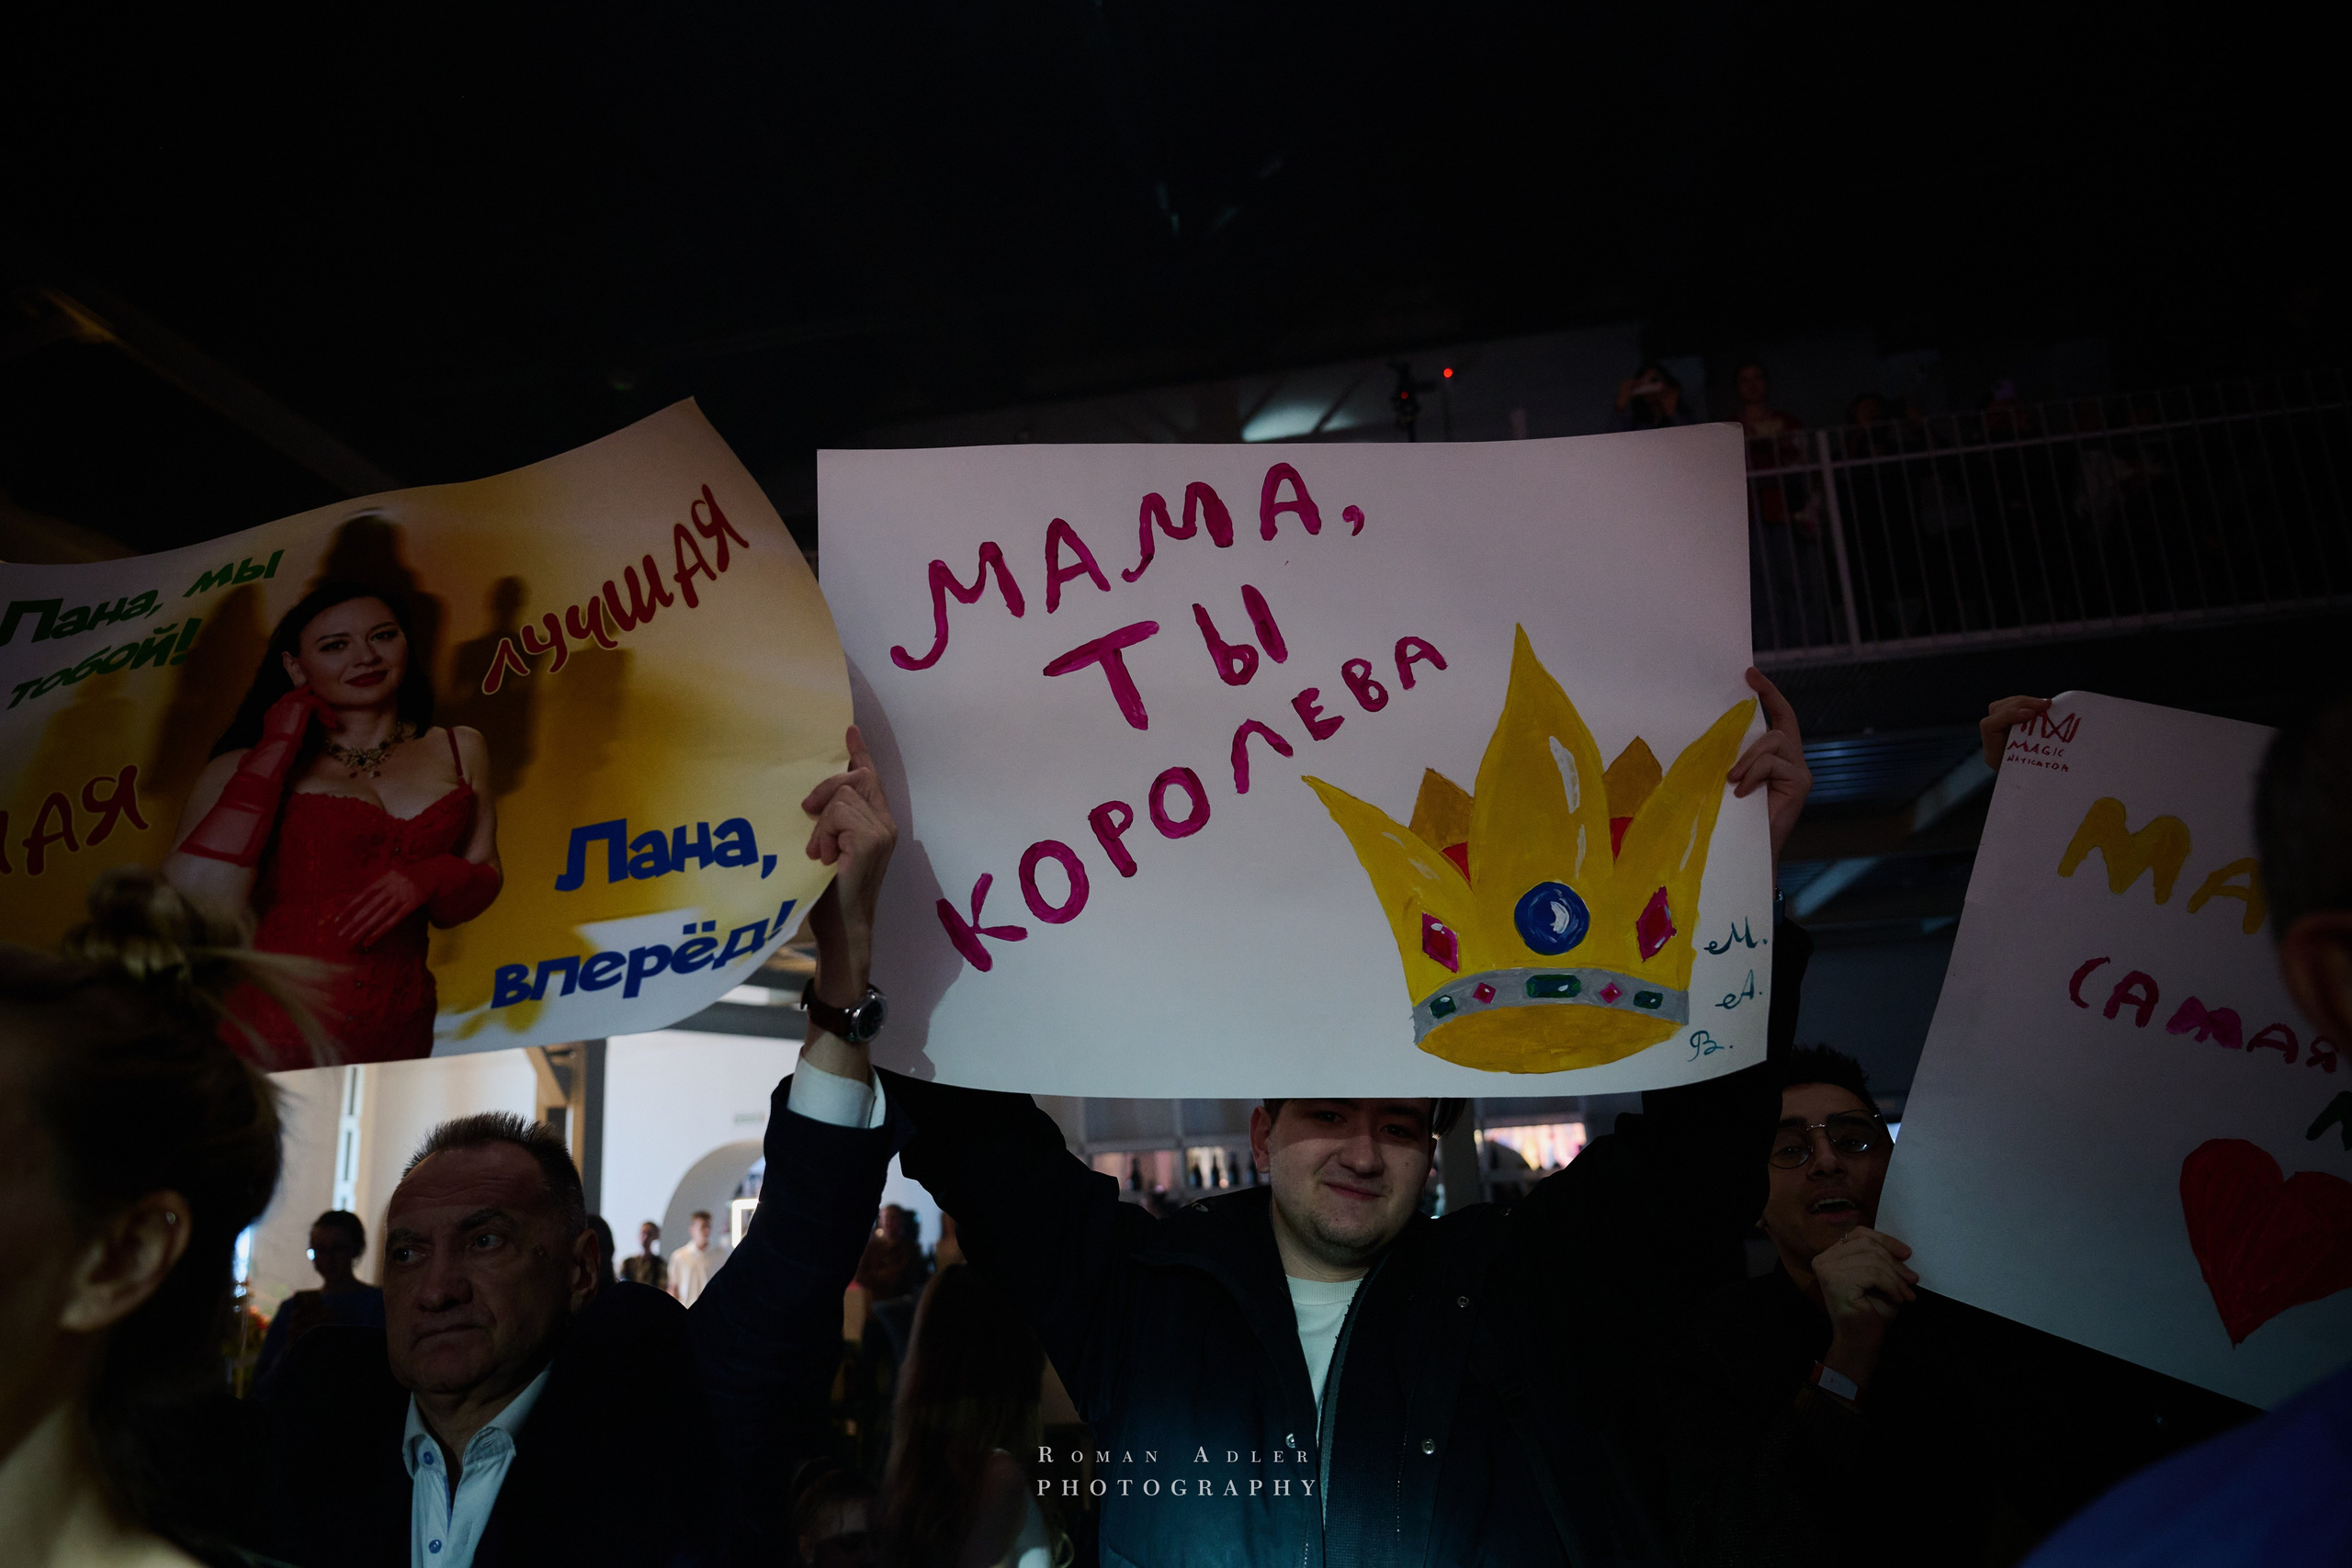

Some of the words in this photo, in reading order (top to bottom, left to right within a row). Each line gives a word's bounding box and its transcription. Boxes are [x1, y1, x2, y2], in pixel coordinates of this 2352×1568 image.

[183, 549, 285, 597] мы
[890, 461, 1365, 671] МАМА,
[6, 617, 203, 710] тобой!
[1043, 583, 1288, 730] ТЫ
[935, 636, 1448, 972] КОРОЛЕВА
[2007, 739, 2064, 757] MAGIC
[554, 817, 778, 892] Лана,
[490, 898, 797, 1010] вперёд!
[2069, 956, 2340, 1074] САМАЯ
